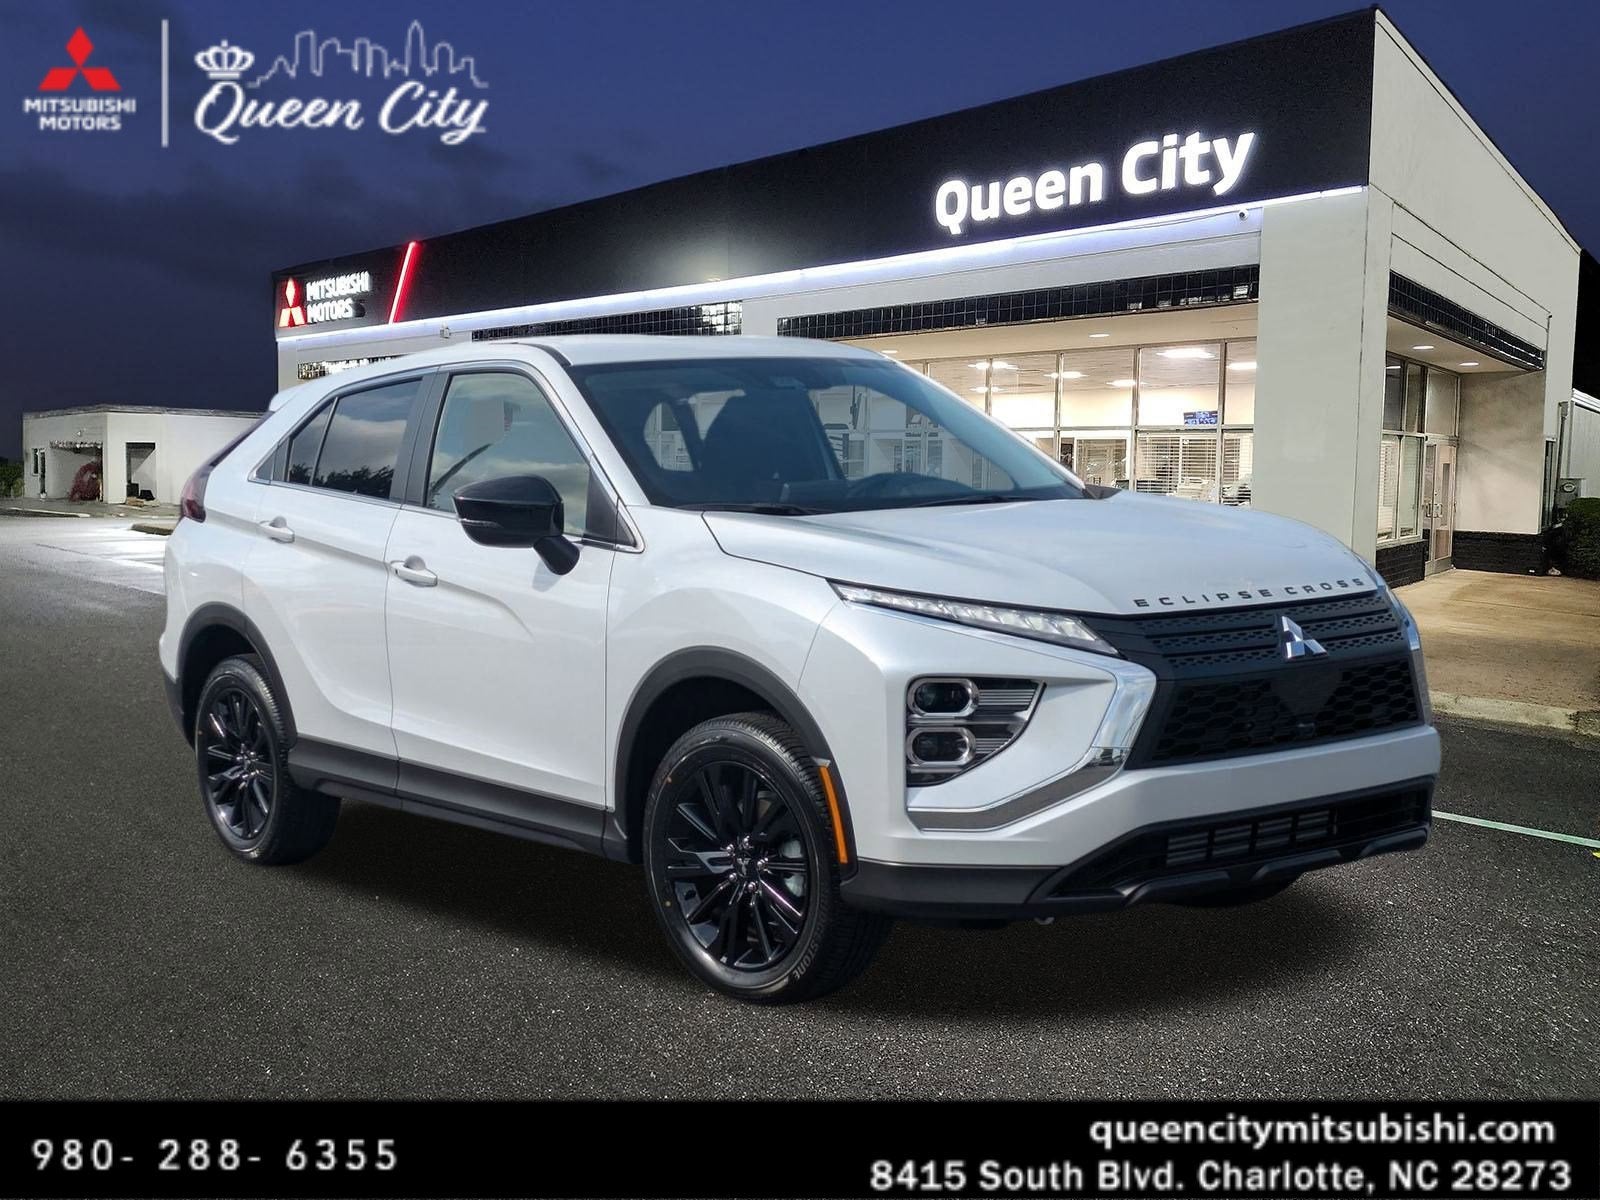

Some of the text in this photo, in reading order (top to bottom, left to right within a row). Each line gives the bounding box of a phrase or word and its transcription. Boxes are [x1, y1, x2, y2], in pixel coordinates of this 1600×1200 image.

[935, 131, 1255, 235] Queen City
[306, 270, 370, 302] MITSUBISHI
[306, 297, 354, 324] MOTORS
[1133, 578, 1365, 608] ECLIPSE CROSS
